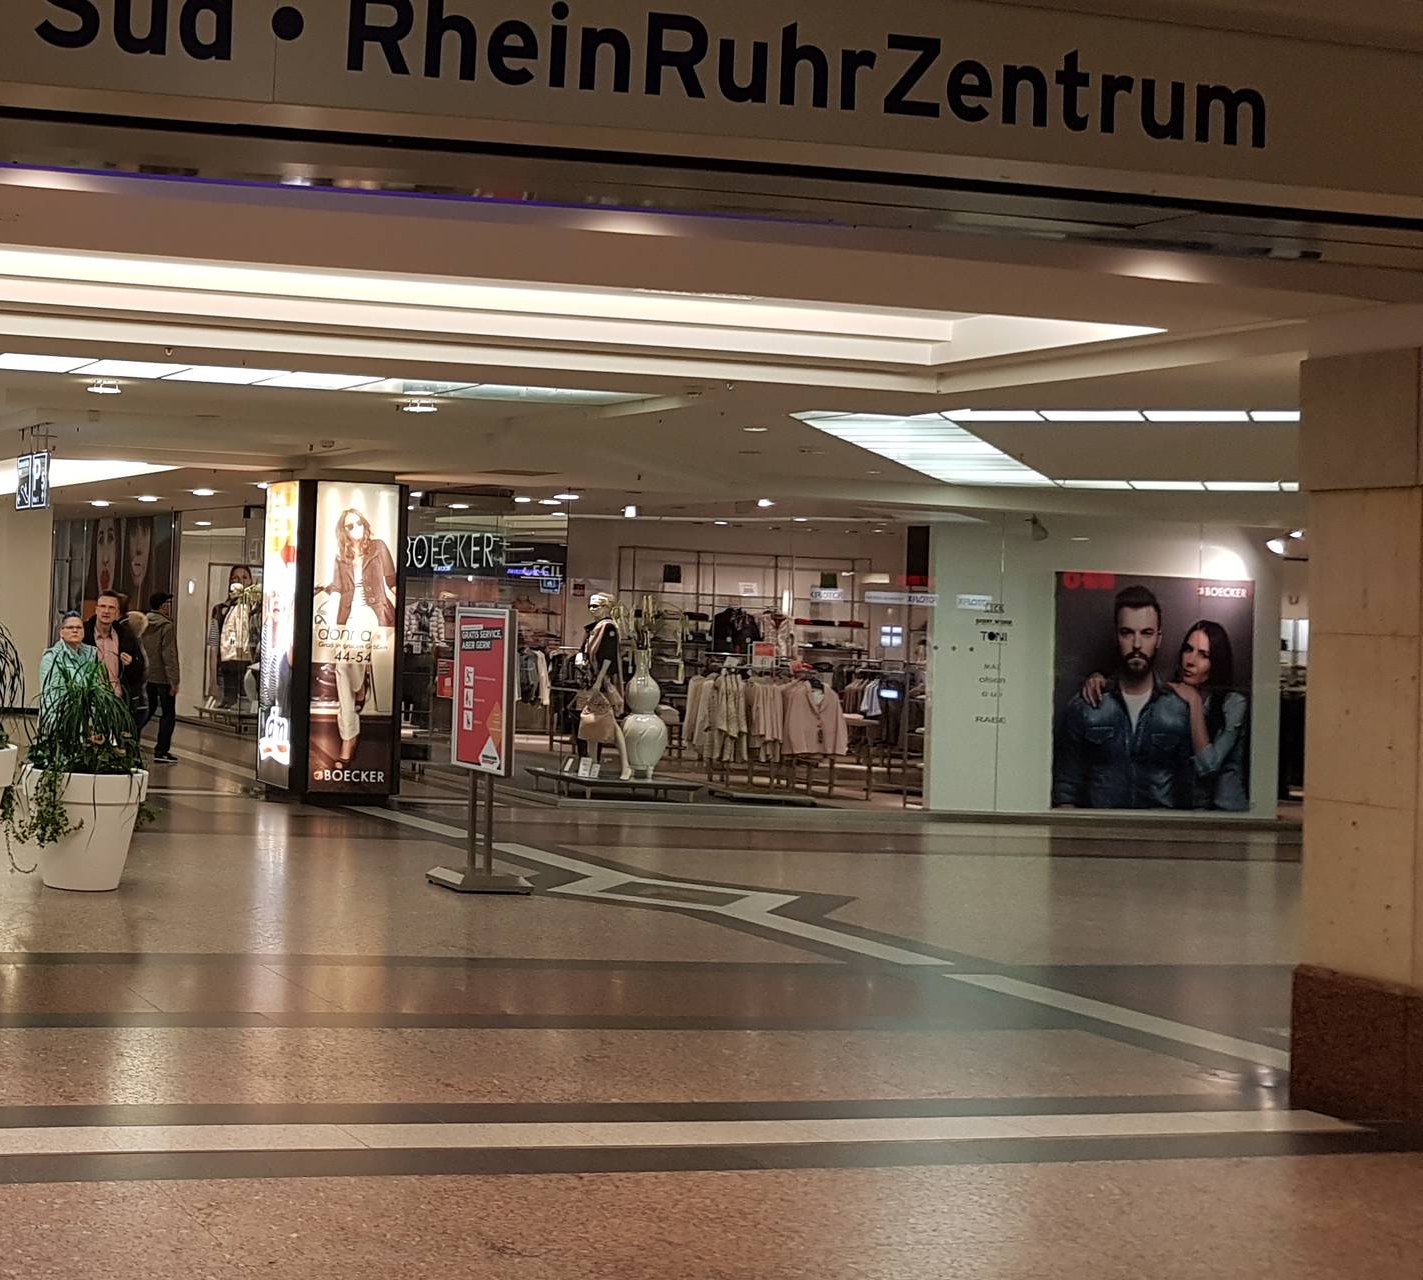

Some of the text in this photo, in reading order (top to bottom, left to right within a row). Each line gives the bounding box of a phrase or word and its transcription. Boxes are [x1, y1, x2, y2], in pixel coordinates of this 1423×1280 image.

[346, 0, 1267, 149] RheinRuhrZentrum
[1204, 587, 1247, 598] BOECKER
[980, 631, 1008, 642] TONI
[334, 651, 371, 663] 44-54
[324, 769, 385, 783] BOECKER
